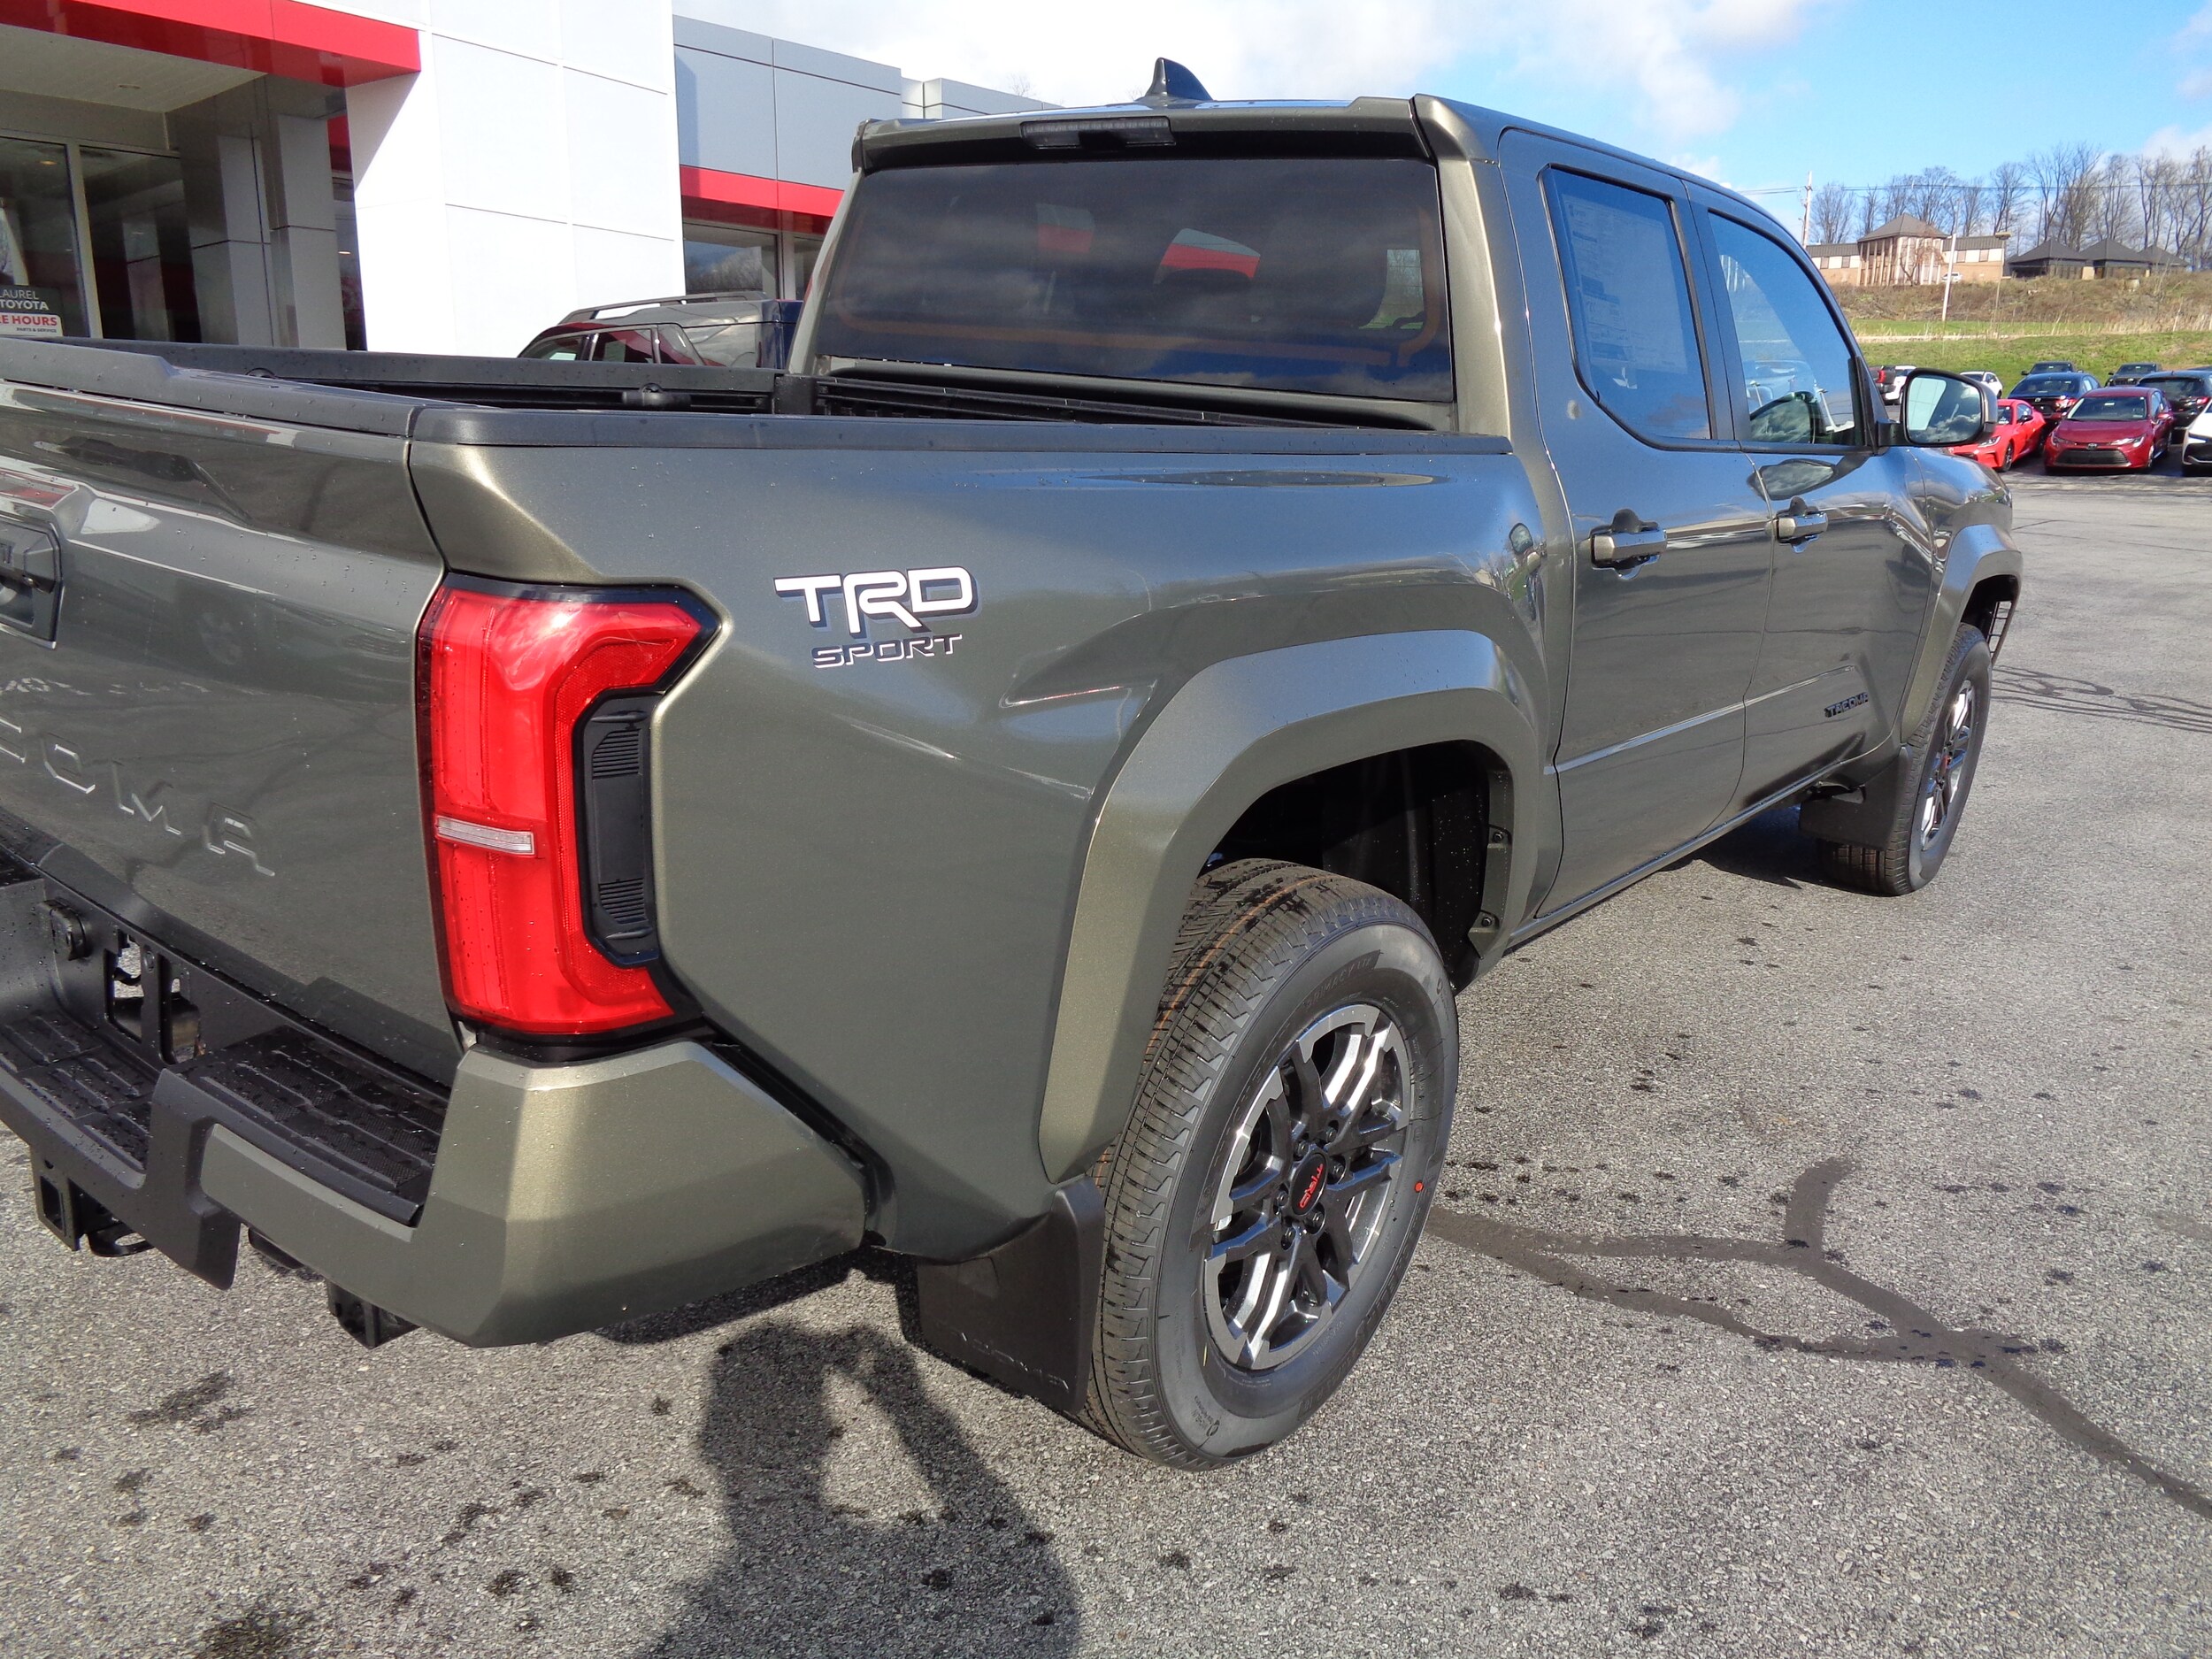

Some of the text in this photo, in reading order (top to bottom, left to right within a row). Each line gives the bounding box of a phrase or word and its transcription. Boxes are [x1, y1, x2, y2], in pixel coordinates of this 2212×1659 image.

[0, 299, 50, 311] TOYOTA
[12, 315, 58, 326] HOURS
[773, 565, 977, 639] TRD
[810, 633, 963, 669] SPORT
[1299, 1163, 1324, 1209] TRD
